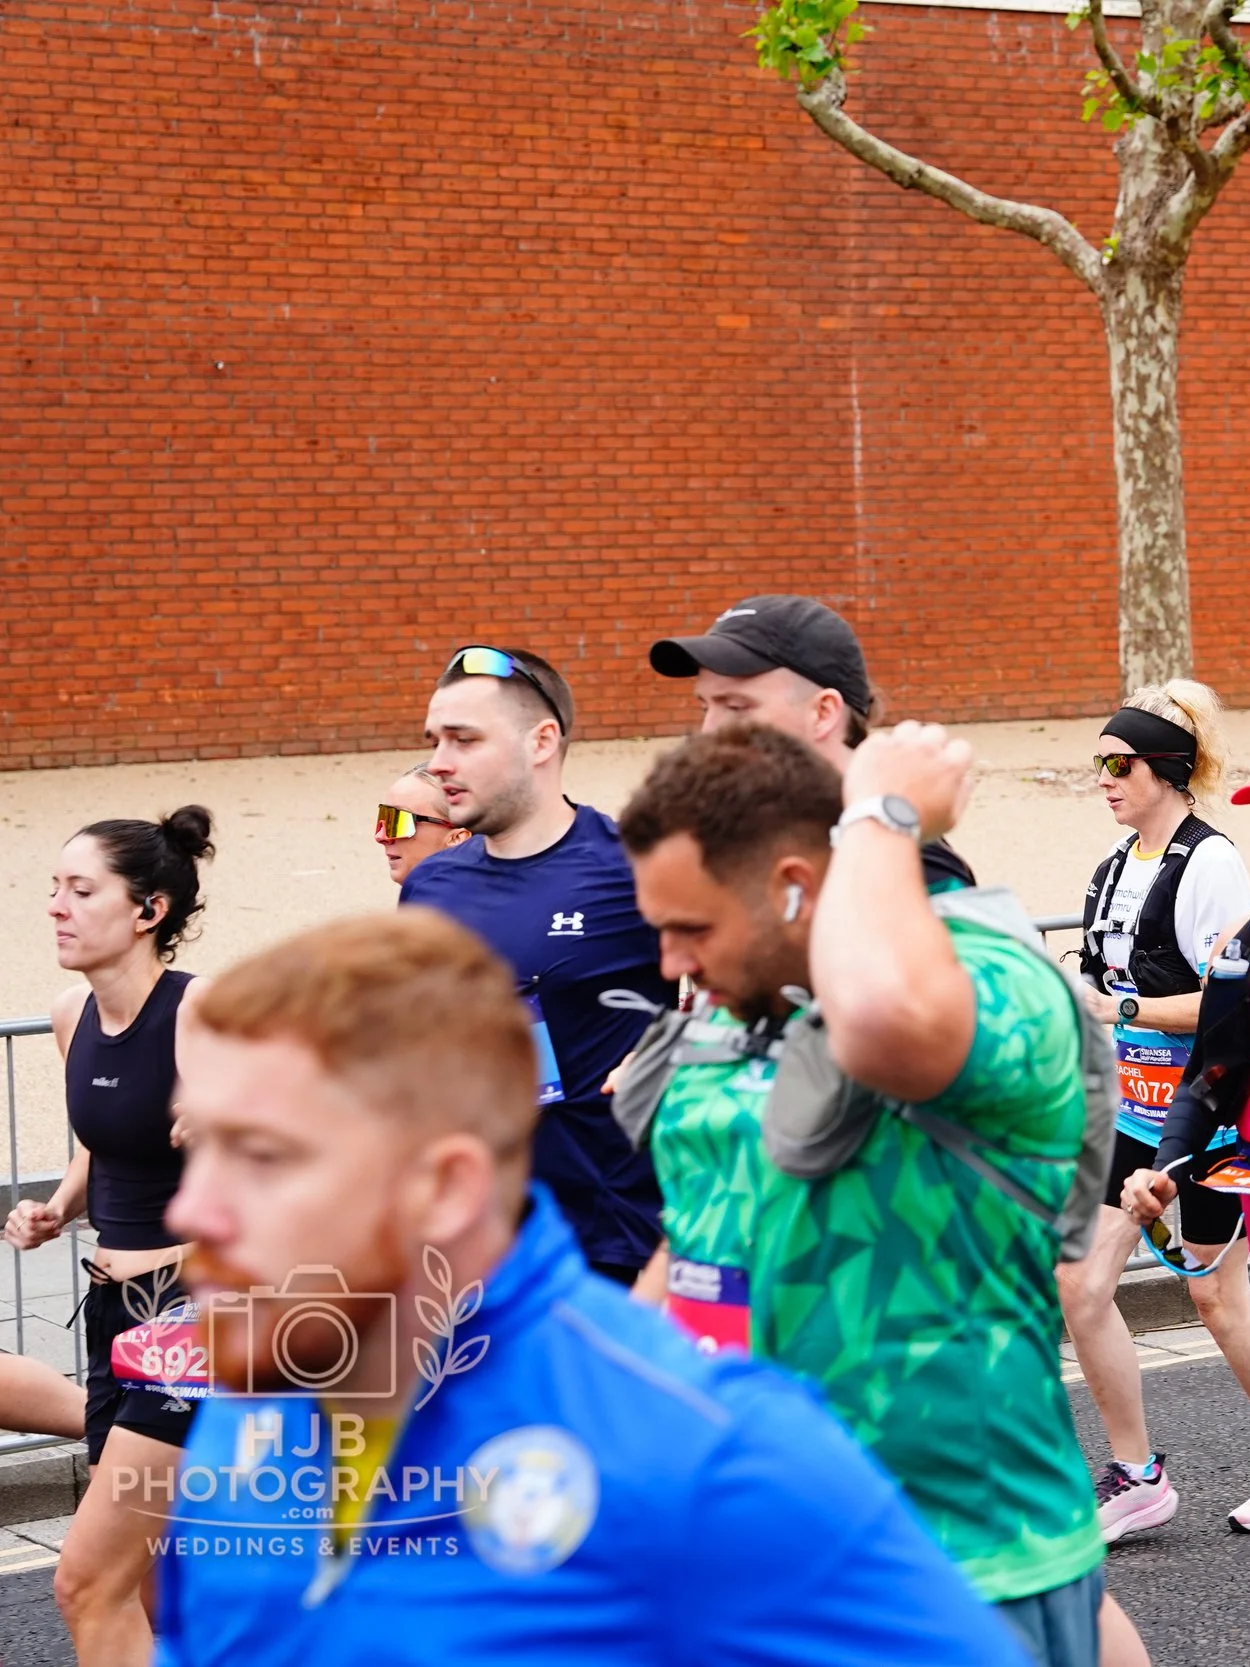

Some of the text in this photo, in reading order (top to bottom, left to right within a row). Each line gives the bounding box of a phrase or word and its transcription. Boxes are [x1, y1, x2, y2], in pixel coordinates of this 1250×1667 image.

[1128, 1078, 1175, 1104] 1072
[116, 1330, 151, 1343] LILY
[141, 1345, 210, 1377] 692
